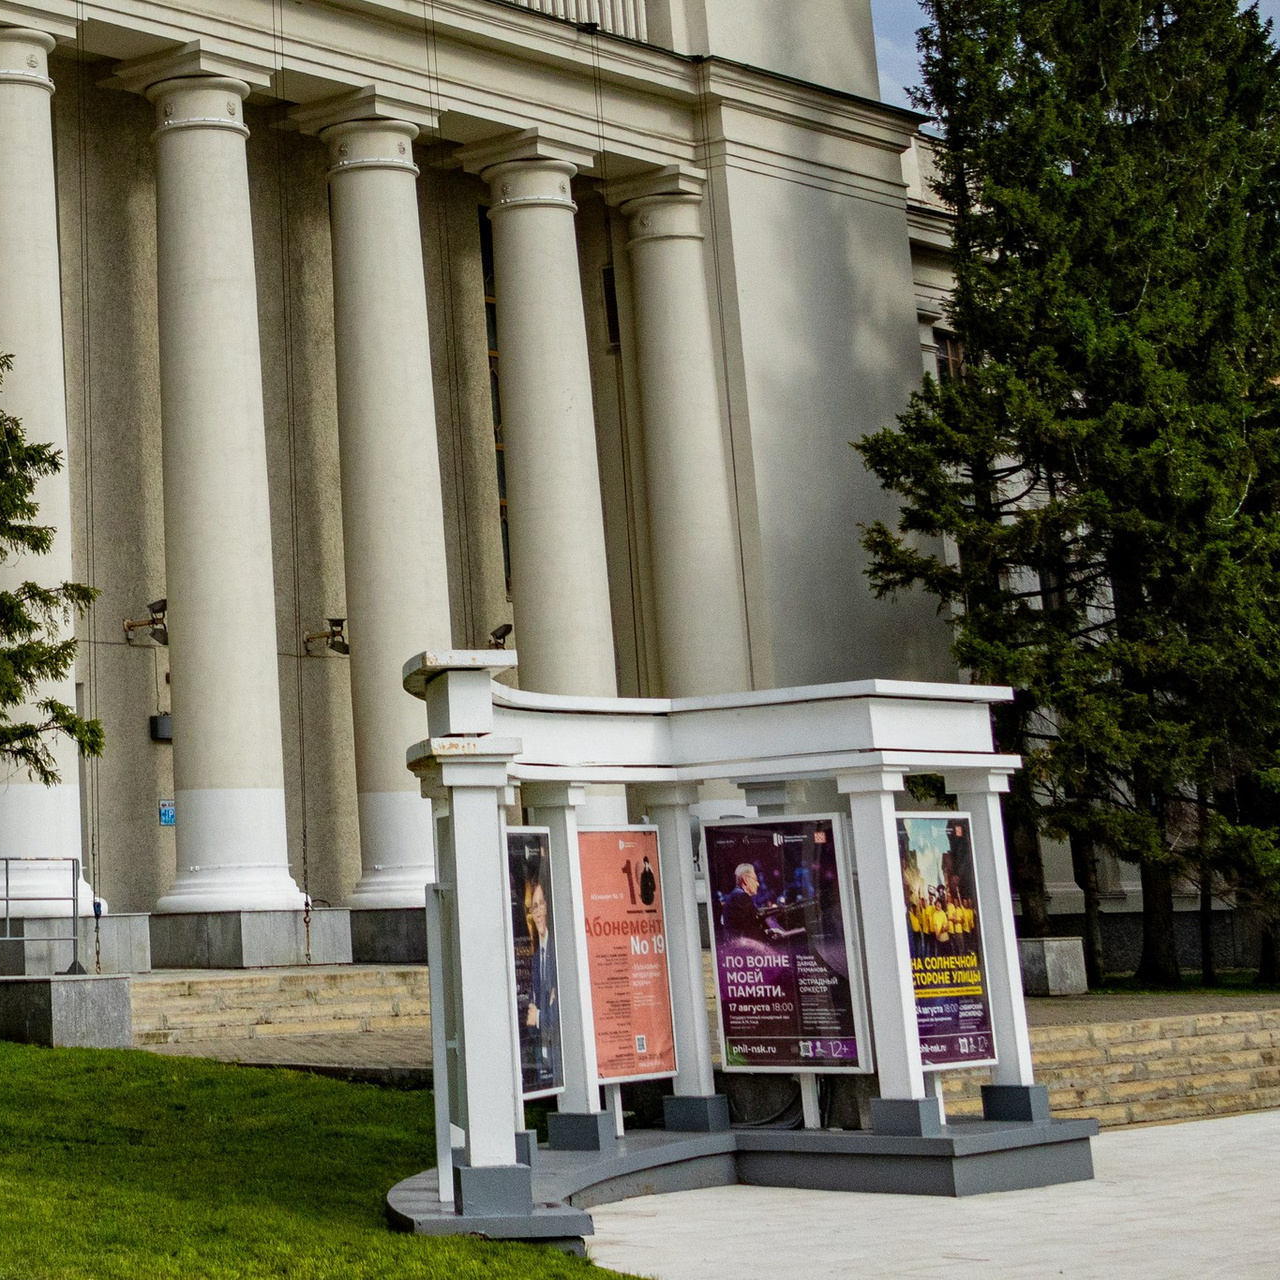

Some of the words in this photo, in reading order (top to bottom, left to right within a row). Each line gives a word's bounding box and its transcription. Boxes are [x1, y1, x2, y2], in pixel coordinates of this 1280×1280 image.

[631, 935, 649, 955] No
[651, 934, 665, 954] 19
[747, 955, 790, 968] ВОЛНЕ
[924, 952, 977, 970] СОЛНЕЧНОЙ
[726, 968, 764, 983] МОЕЙ
[798, 976, 839, 986] ЭСТРАДНЫЙ
[952, 970, 981, 984] УЛИЦЫ
[729, 1003, 737, 1012] 17
[738, 1004, 771, 1014] августа
[771, 1002, 794, 1012] 18:00
[732, 1044, 777, 1055] phil-nsk.ru
[829, 1041, 849, 1058] 12+
